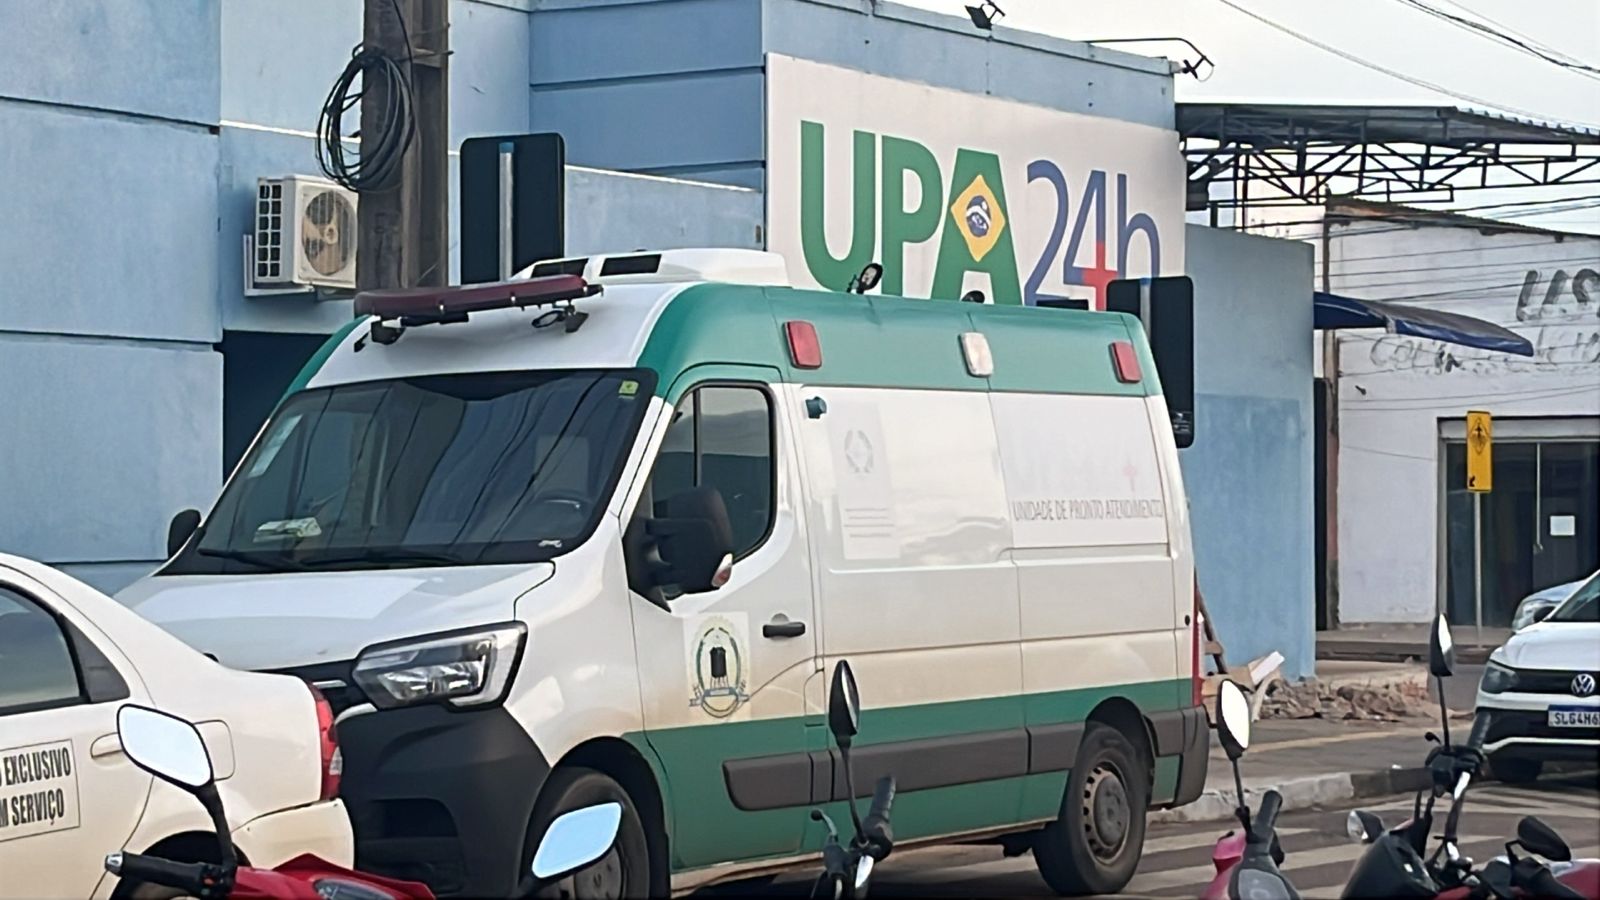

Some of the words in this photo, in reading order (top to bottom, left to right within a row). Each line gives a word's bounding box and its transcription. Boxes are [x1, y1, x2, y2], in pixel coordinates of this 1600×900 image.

[800, 120, 1023, 306] UPA
[1024, 159, 1161, 311] 24h
[1012, 500, 1054, 521] UNIDADE
[1055, 500, 1068, 520] DE
[1069, 499, 1103, 519] PRONTO
[1105, 499, 1163, 519] ATENDIMENTO
[1554, 712, 1600, 726] SLG4H6
[3, 747, 71, 786] EXCLUSIVO
[11, 788, 64, 826] SERVIÇO
